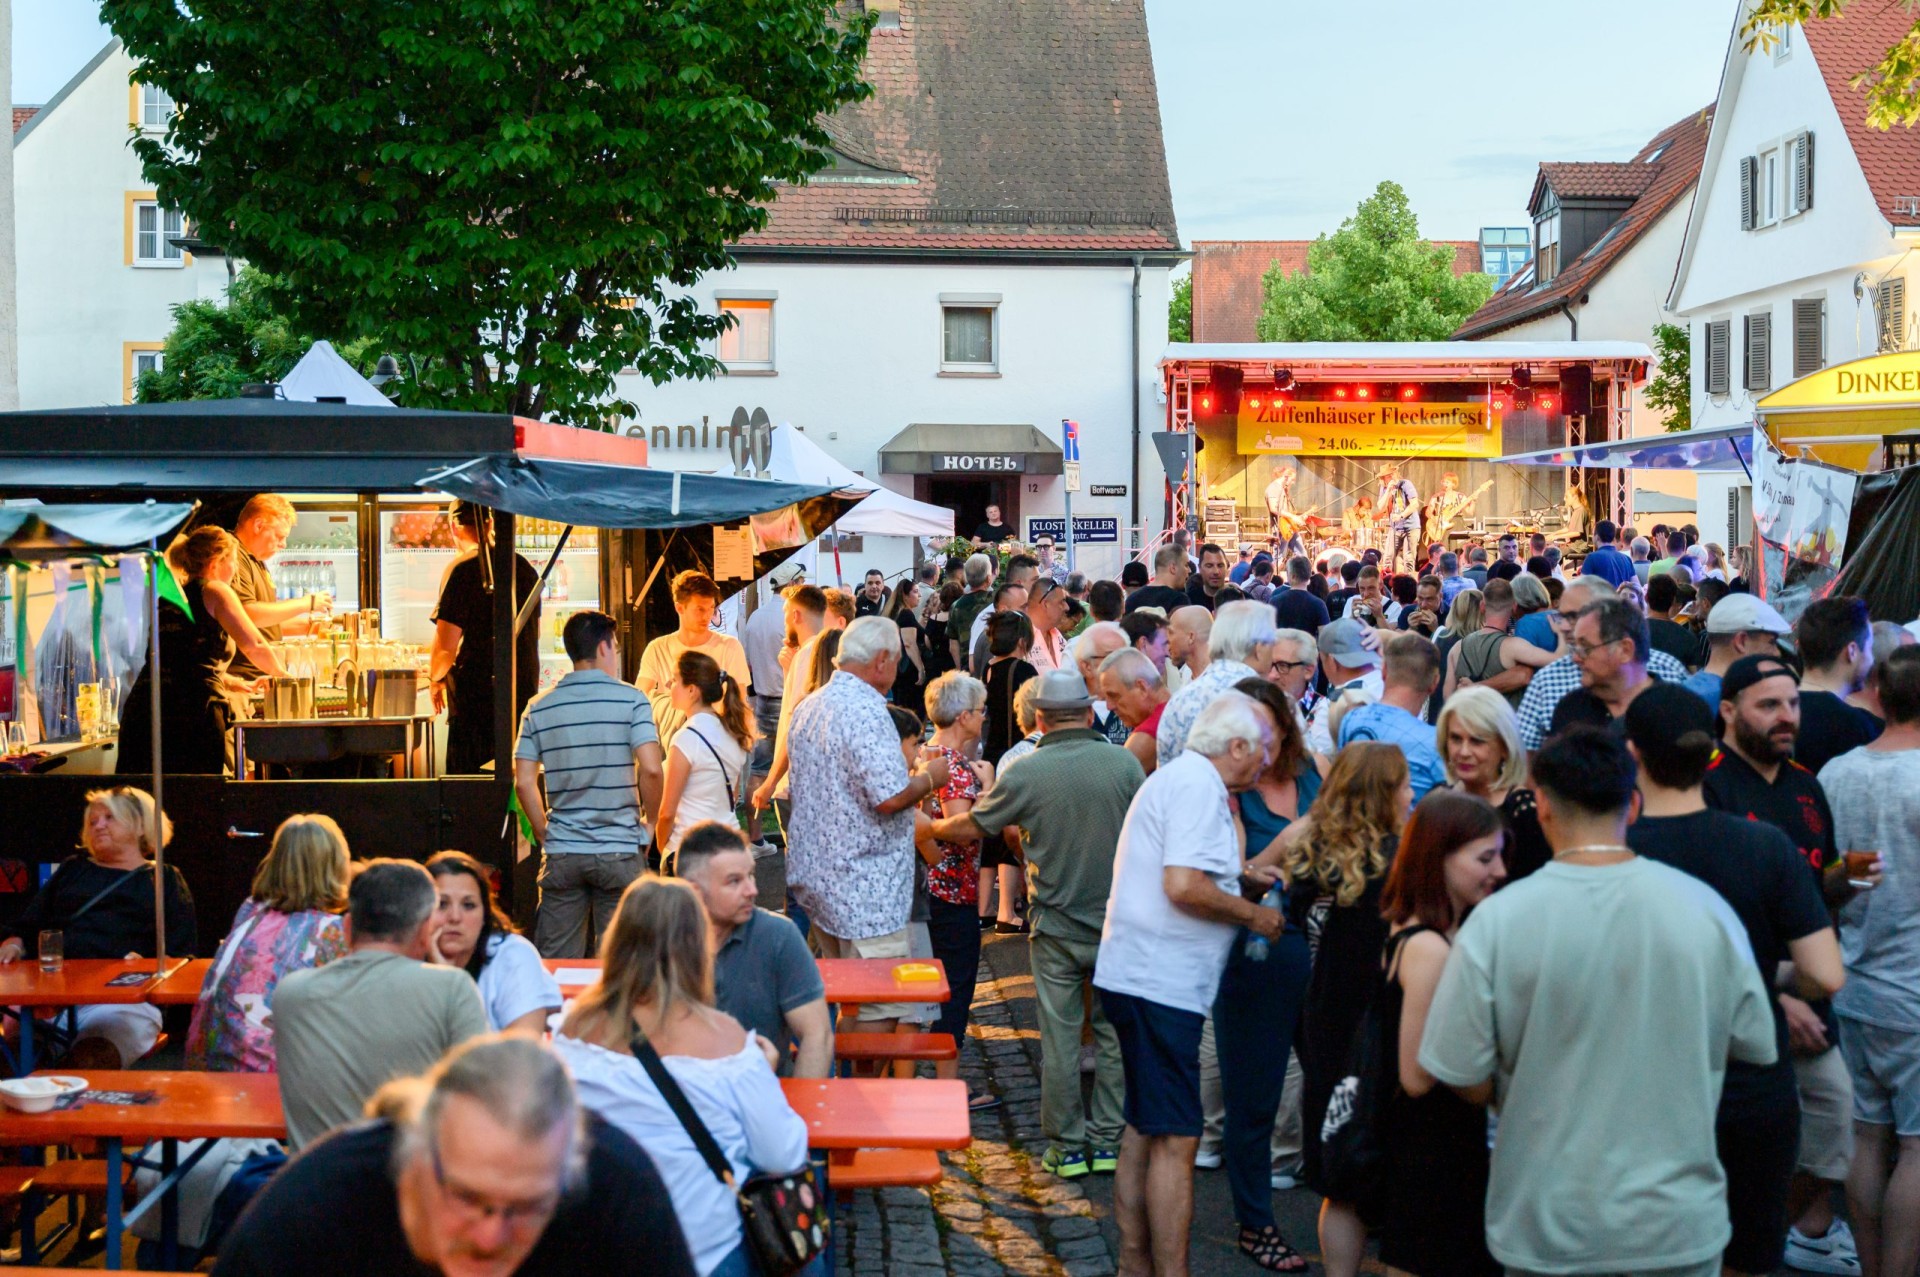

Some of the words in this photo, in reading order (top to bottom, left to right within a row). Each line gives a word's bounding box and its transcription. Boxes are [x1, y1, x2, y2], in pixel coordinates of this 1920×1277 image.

[1836, 370, 1920, 394] DINKE
[1256, 405, 1375, 425] Zuffenhäuser
[1381, 406, 1484, 426] Fleckenfest
[1318, 437, 1362, 450] 24.06.
[1378, 438, 1421, 451] 27.06.
[943, 455, 1017, 471] HOTEL
[1028, 483, 1039, 493] 12
[1091, 485, 1126, 495] Bottwarstr.
[1032, 520, 1115, 531] KLOSTRKELLER
